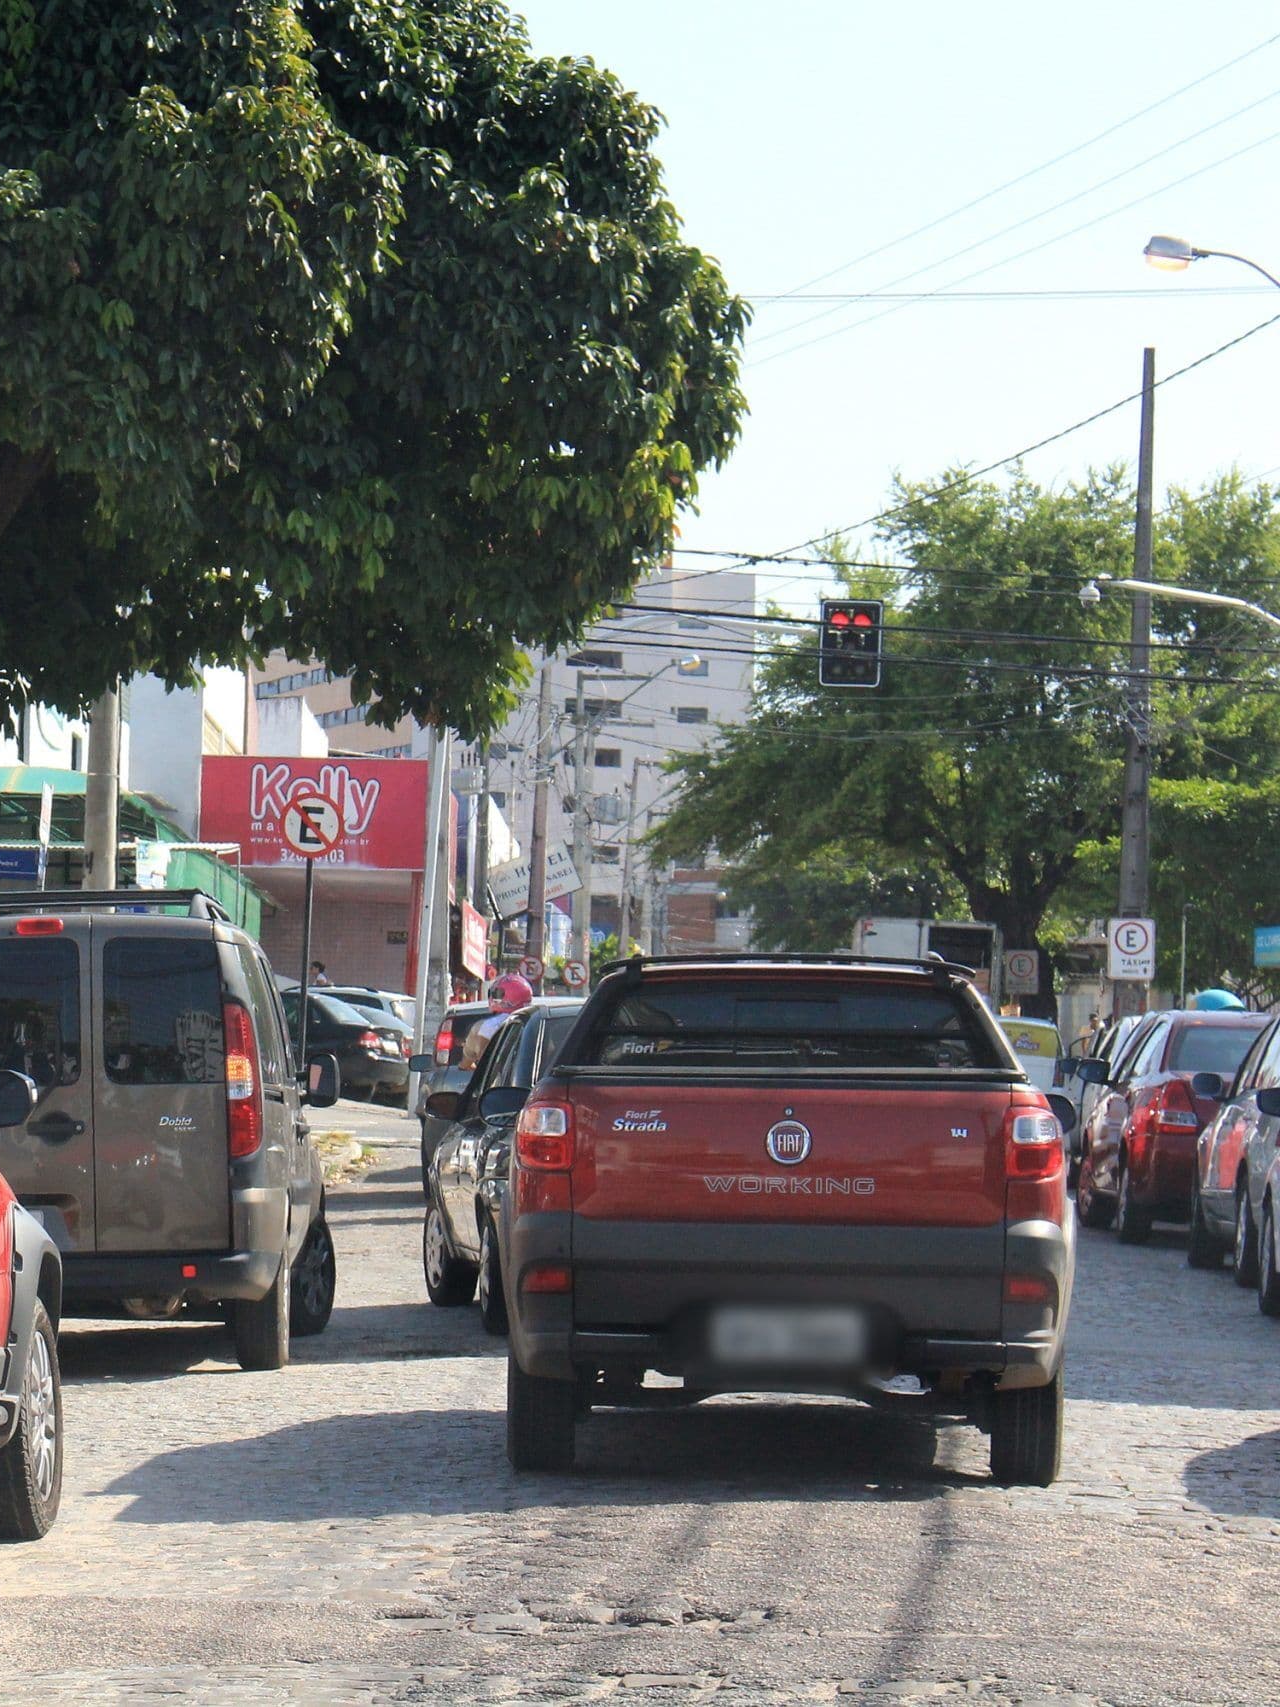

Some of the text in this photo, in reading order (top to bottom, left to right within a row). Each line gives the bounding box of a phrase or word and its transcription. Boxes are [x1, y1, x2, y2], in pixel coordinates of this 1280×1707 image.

[298, 806, 325, 844] E
[1126, 930, 1137, 947] E
[622, 1042, 656, 1054] Fiori
[625, 1110, 648, 1119] Fiori
[612, 1118, 668, 1132] Strada
[776, 1133, 801, 1153] FIAT
[703, 1175, 876, 1195] WORKING
